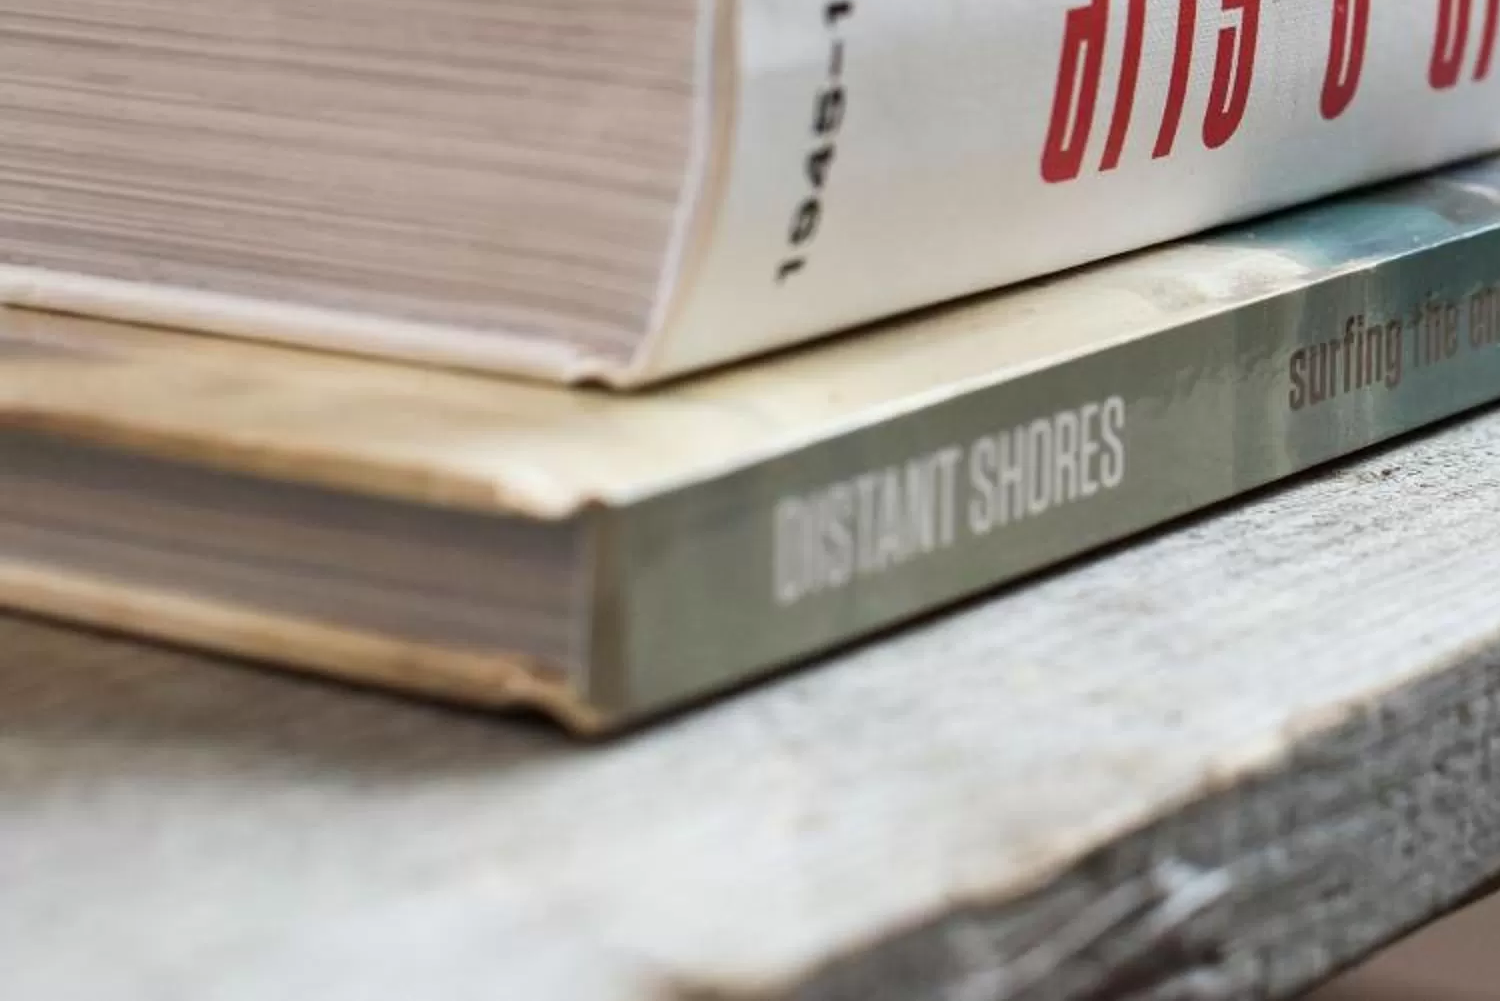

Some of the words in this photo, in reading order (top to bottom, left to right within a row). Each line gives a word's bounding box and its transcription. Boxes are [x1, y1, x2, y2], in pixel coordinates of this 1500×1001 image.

[1289, 314, 1402, 411] surfing
[1403, 289, 1460, 367] the
[773, 443, 963, 607] DISTANT
[968, 395, 1125, 536] SHORES
